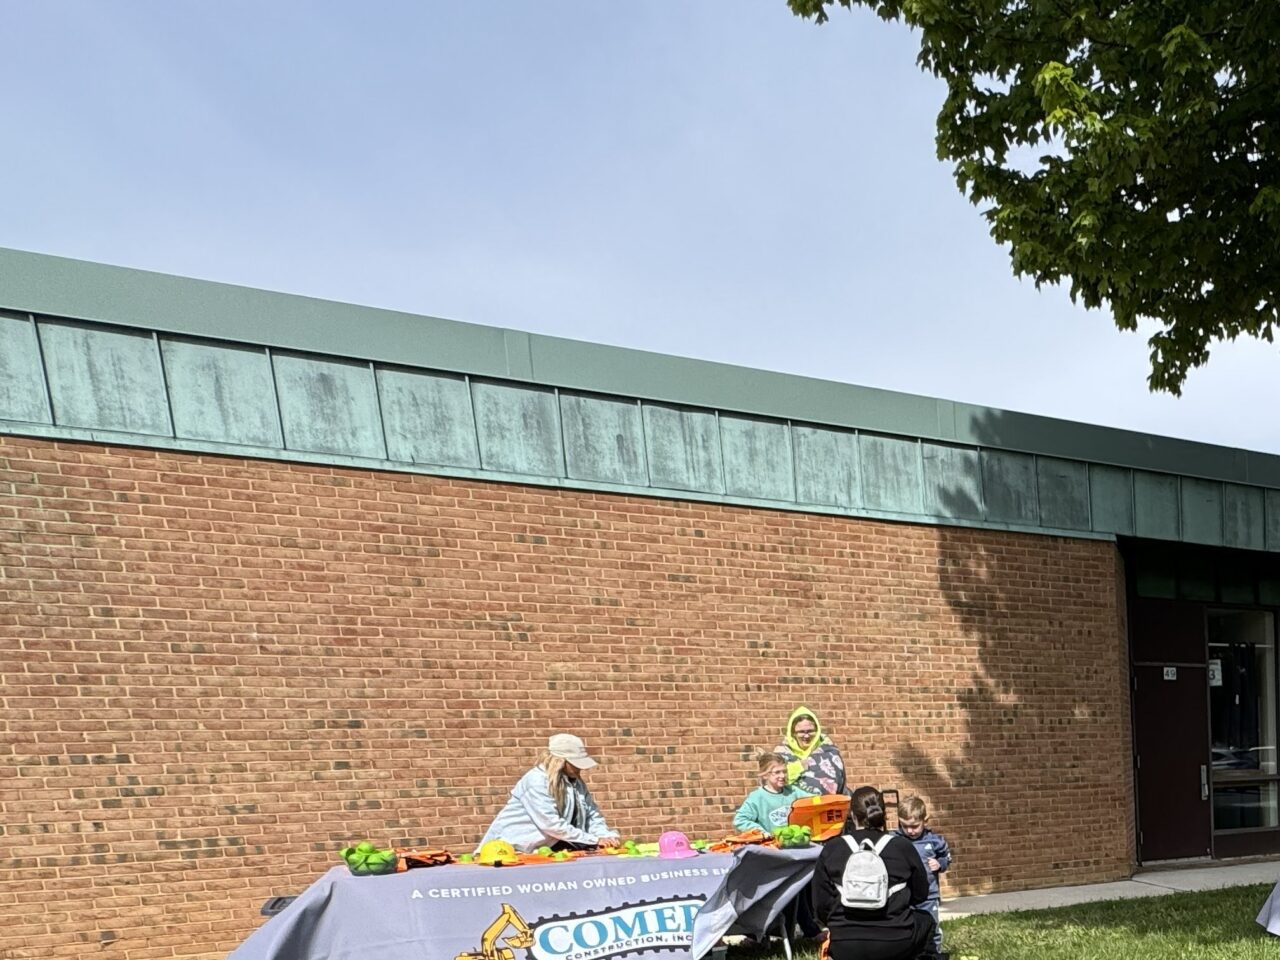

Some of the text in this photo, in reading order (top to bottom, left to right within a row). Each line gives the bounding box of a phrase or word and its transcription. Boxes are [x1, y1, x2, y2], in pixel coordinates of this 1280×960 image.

[411, 889, 424, 899] A
[428, 885, 513, 899] CERTIFIED
[516, 880, 578, 894] WOMAN
[582, 875, 637, 889] OWNED
[640, 867, 708, 883] BUSINESS
